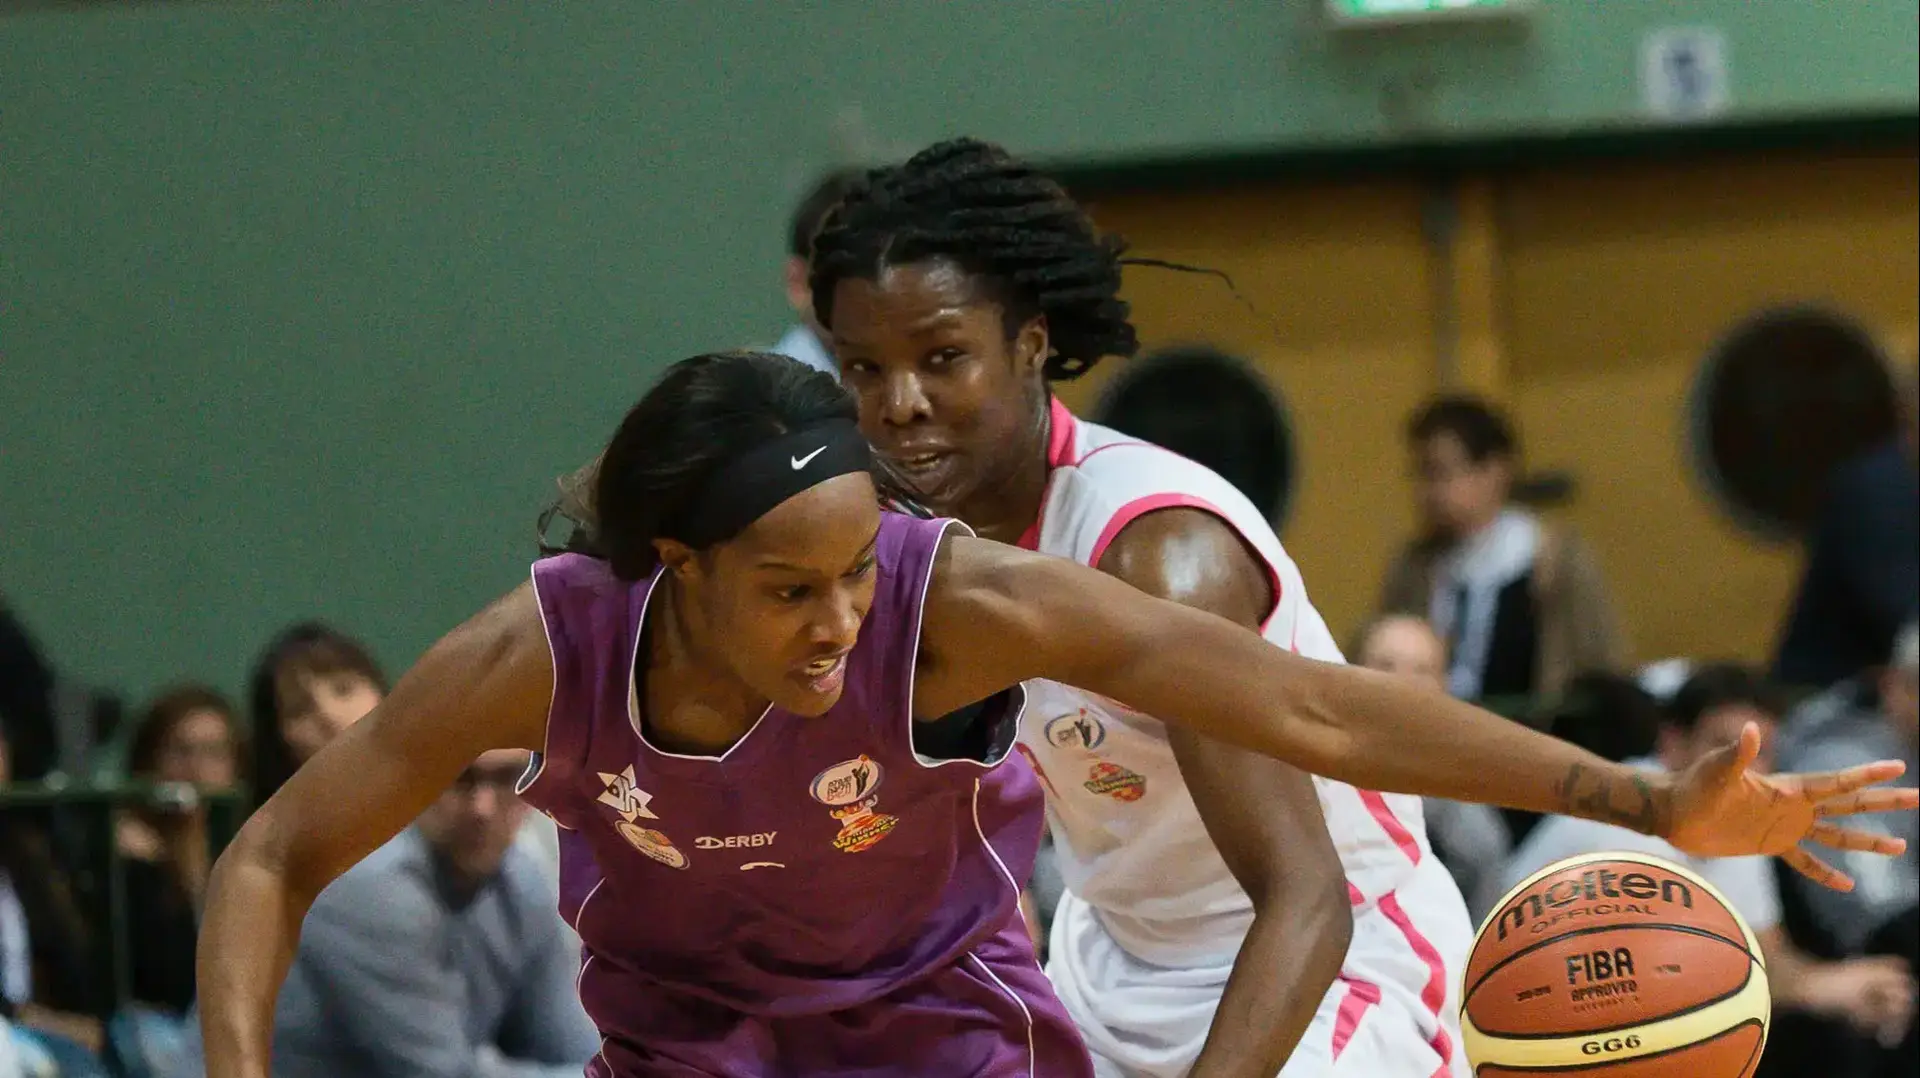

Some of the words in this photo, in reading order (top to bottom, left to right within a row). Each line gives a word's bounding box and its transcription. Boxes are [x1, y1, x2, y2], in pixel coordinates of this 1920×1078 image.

[695, 831, 777, 849] DERBY
[1498, 869, 1692, 941] molten
[1530, 904, 1658, 934] OFFICIAL
[1566, 947, 1634, 985] FIBA
[1571, 979, 1638, 1001] APPROVED
[1581, 1034, 1642, 1055] GG6
